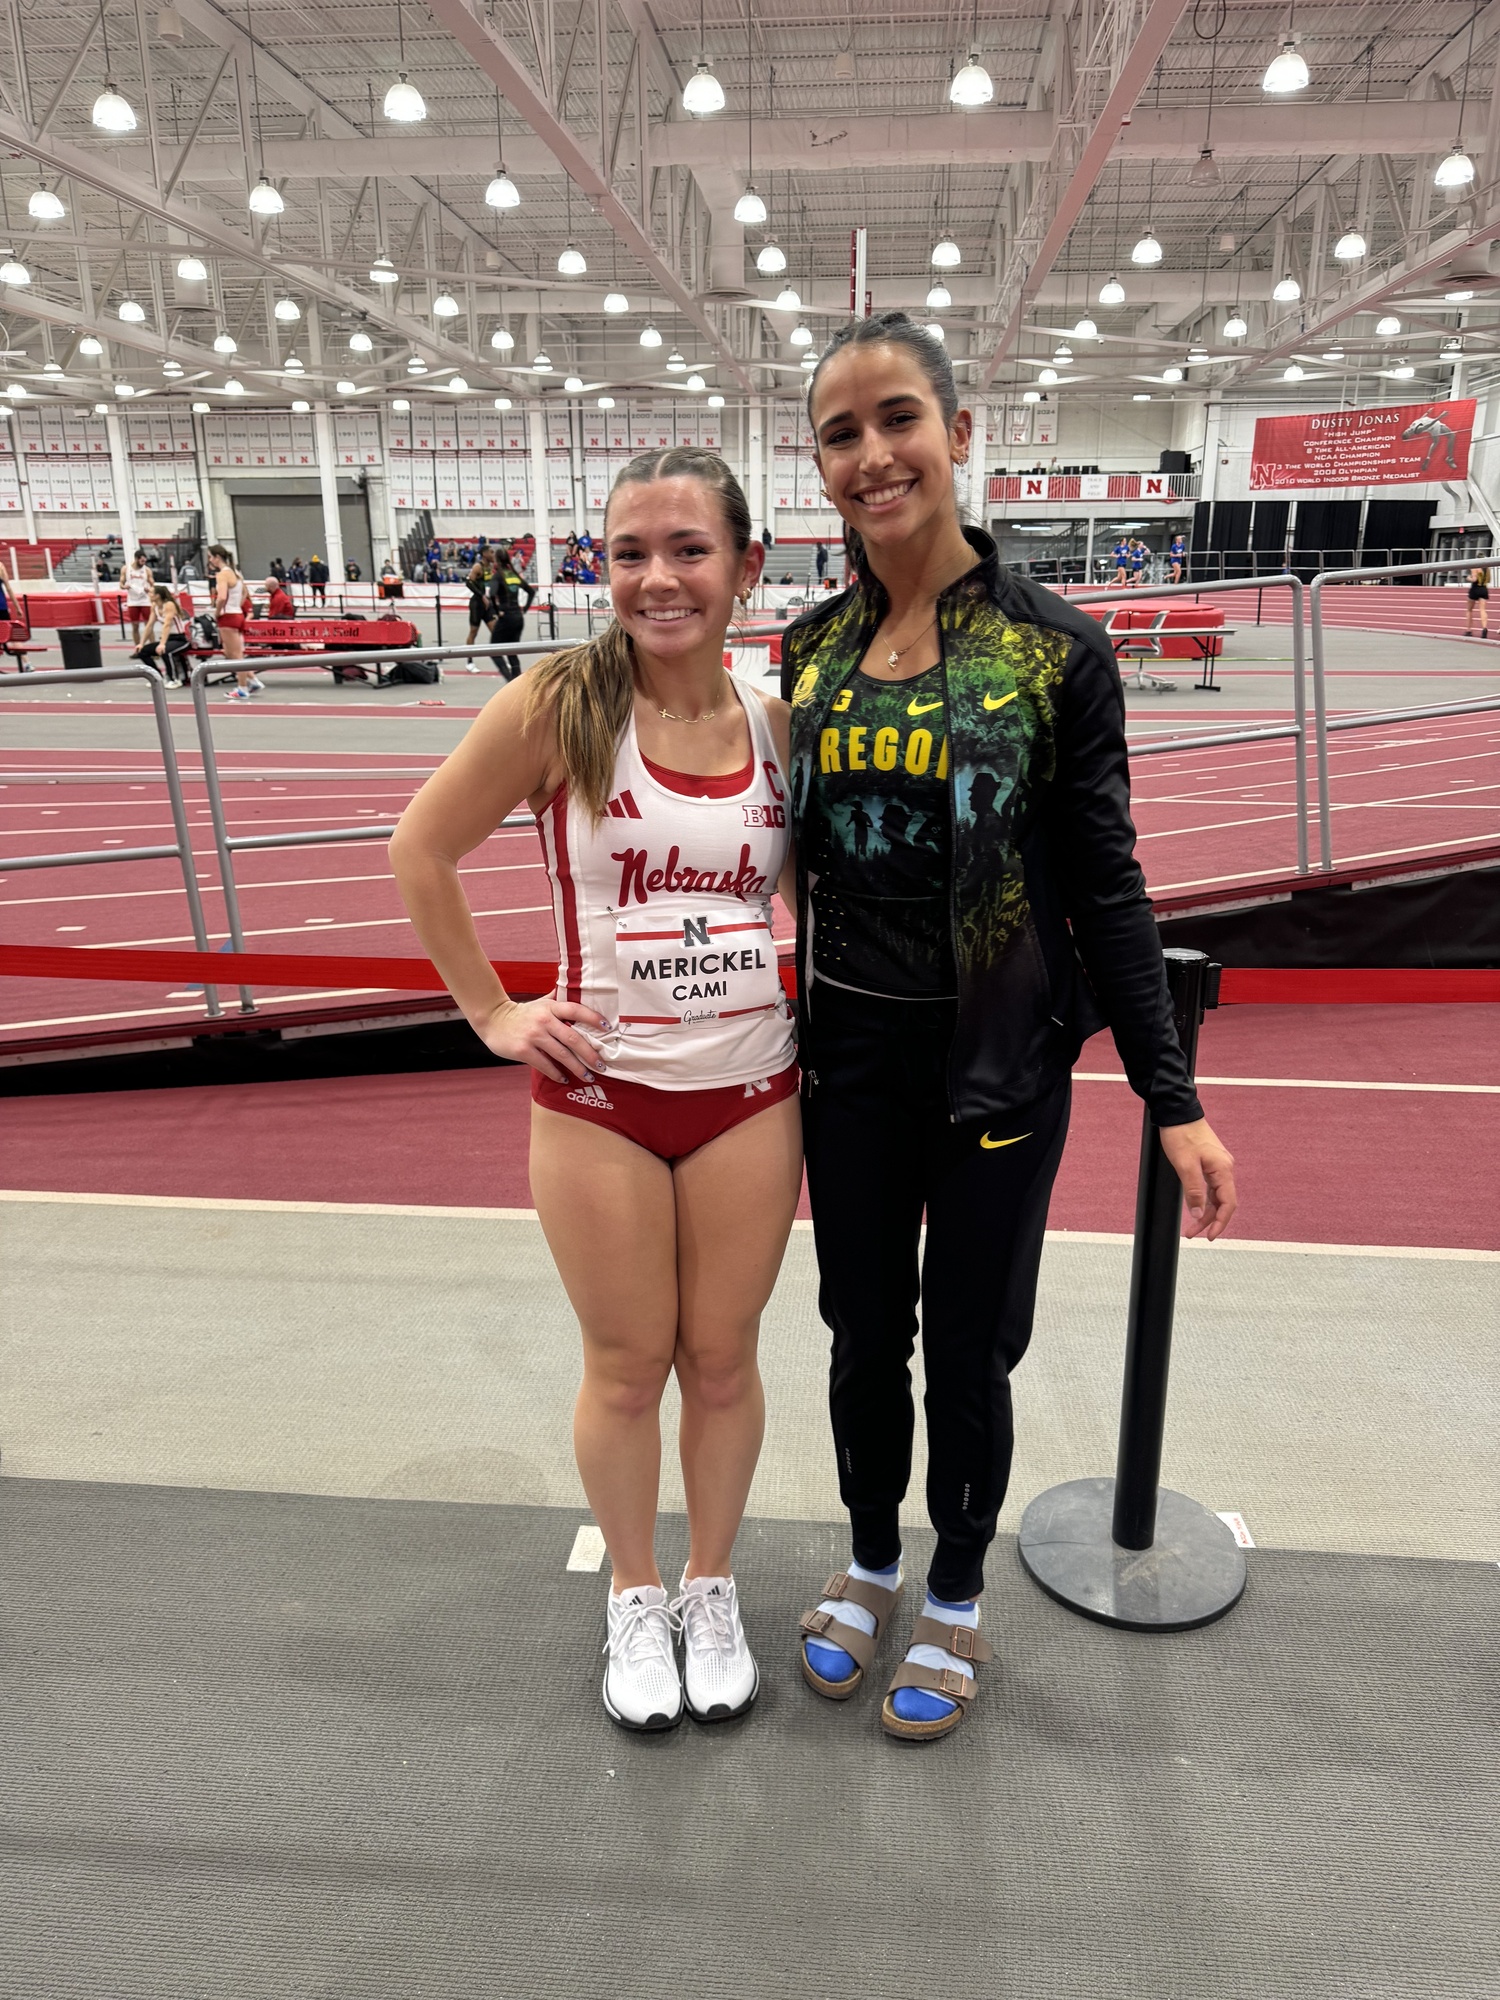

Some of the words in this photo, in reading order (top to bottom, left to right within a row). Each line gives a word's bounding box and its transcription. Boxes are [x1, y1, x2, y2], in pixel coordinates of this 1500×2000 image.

[1312, 418, 1352, 430] DUSTY
[1358, 413, 1400, 428] JONAS
[614, 438, 622, 447] N
[1334, 458, 1396, 467] CHAMPIONSHIPS
[1254, 463, 1276, 486] N
[1027, 480, 1042, 494] N
[1147, 479, 1162, 493] N
[593, 498, 601, 507] N
[244, 627, 285, 637] ebraska
[290, 626, 318, 636] Track
[334, 627, 359, 637] Field
[813, 726, 948, 780] REGO
[762, 760, 785, 802] C
[610, 843, 767, 907] Nebraska
[683, 916, 714, 947] N
[630, 949, 766, 980] MERICKEL
[672, 981, 727, 1001] CAMI
[684, 1010, 716, 1025] Graduate
[566, 1090, 614, 1110] adidas
